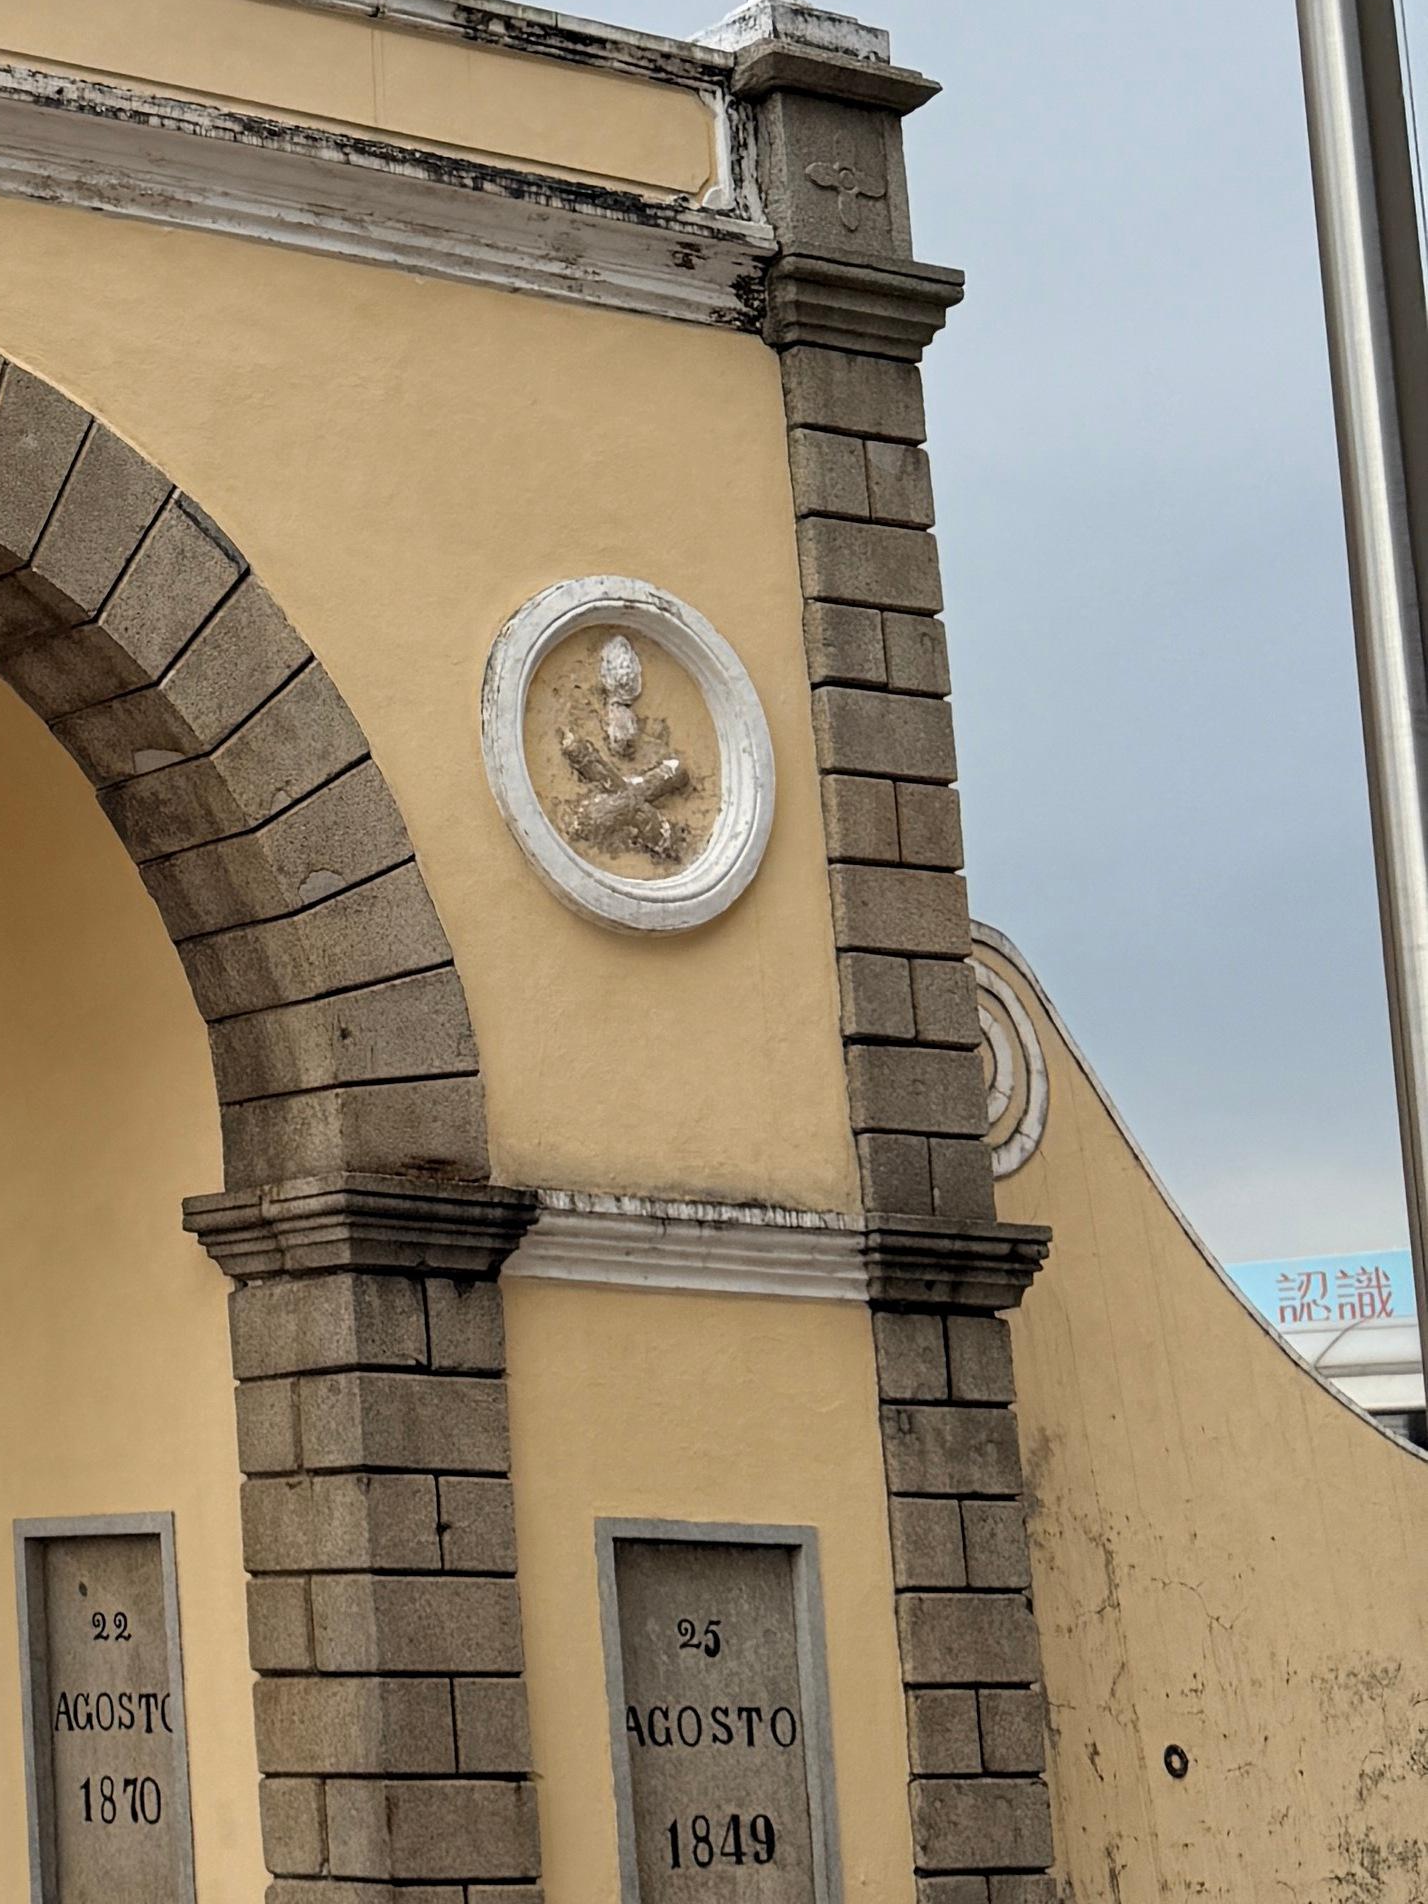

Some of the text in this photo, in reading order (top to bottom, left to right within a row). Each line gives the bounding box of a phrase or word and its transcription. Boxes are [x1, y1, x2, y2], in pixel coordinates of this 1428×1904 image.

[1276, 1265, 1394, 1324] 認識
[91, 1612, 132, 1641] 22
[677, 1619, 722, 1658] 25
[626, 1705, 796, 1747] AGOSTO
[80, 1776, 162, 1825] 1870
[668, 1814, 776, 1870] 1849
